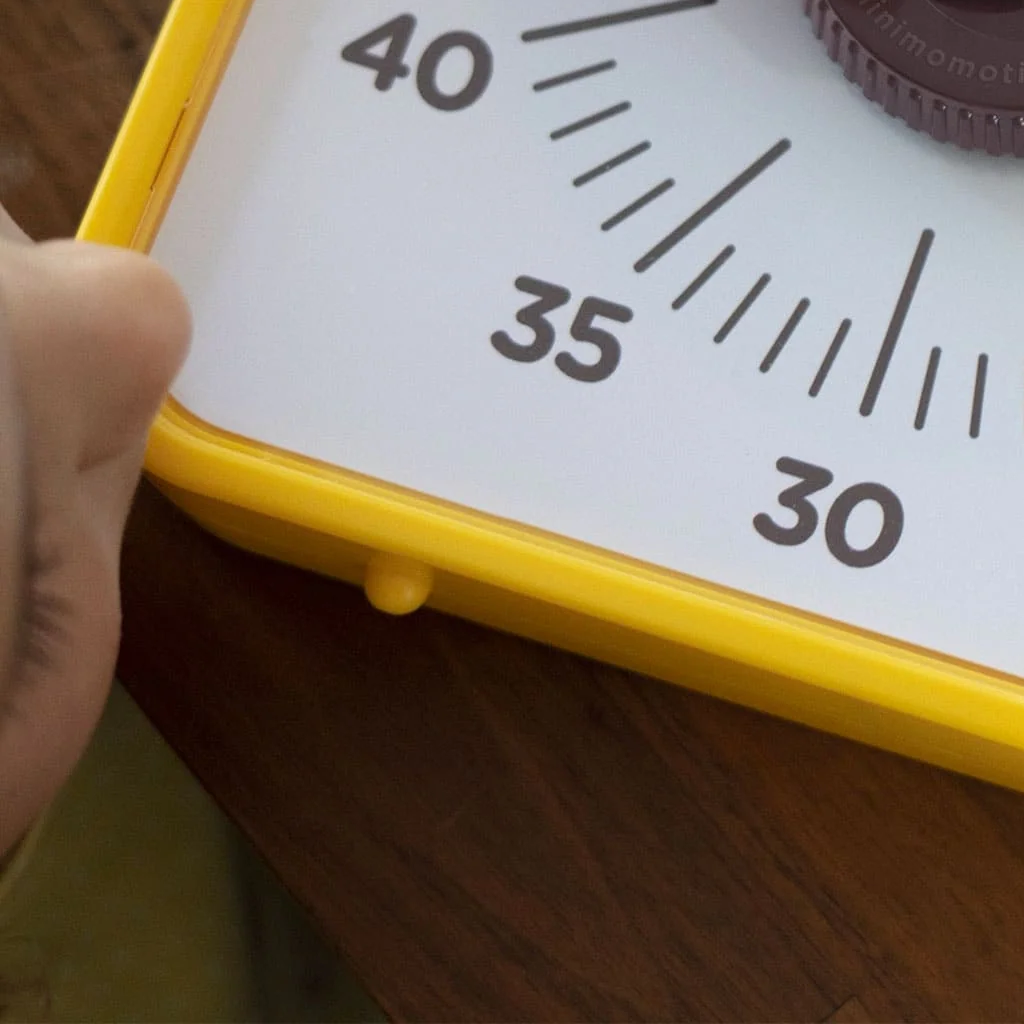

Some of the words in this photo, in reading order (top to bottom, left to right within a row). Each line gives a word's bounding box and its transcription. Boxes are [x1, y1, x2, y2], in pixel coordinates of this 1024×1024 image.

[339, 12, 494, 114] 40
[489, 274, 635, 385] 35
[751, 455, 905, 570] 30
